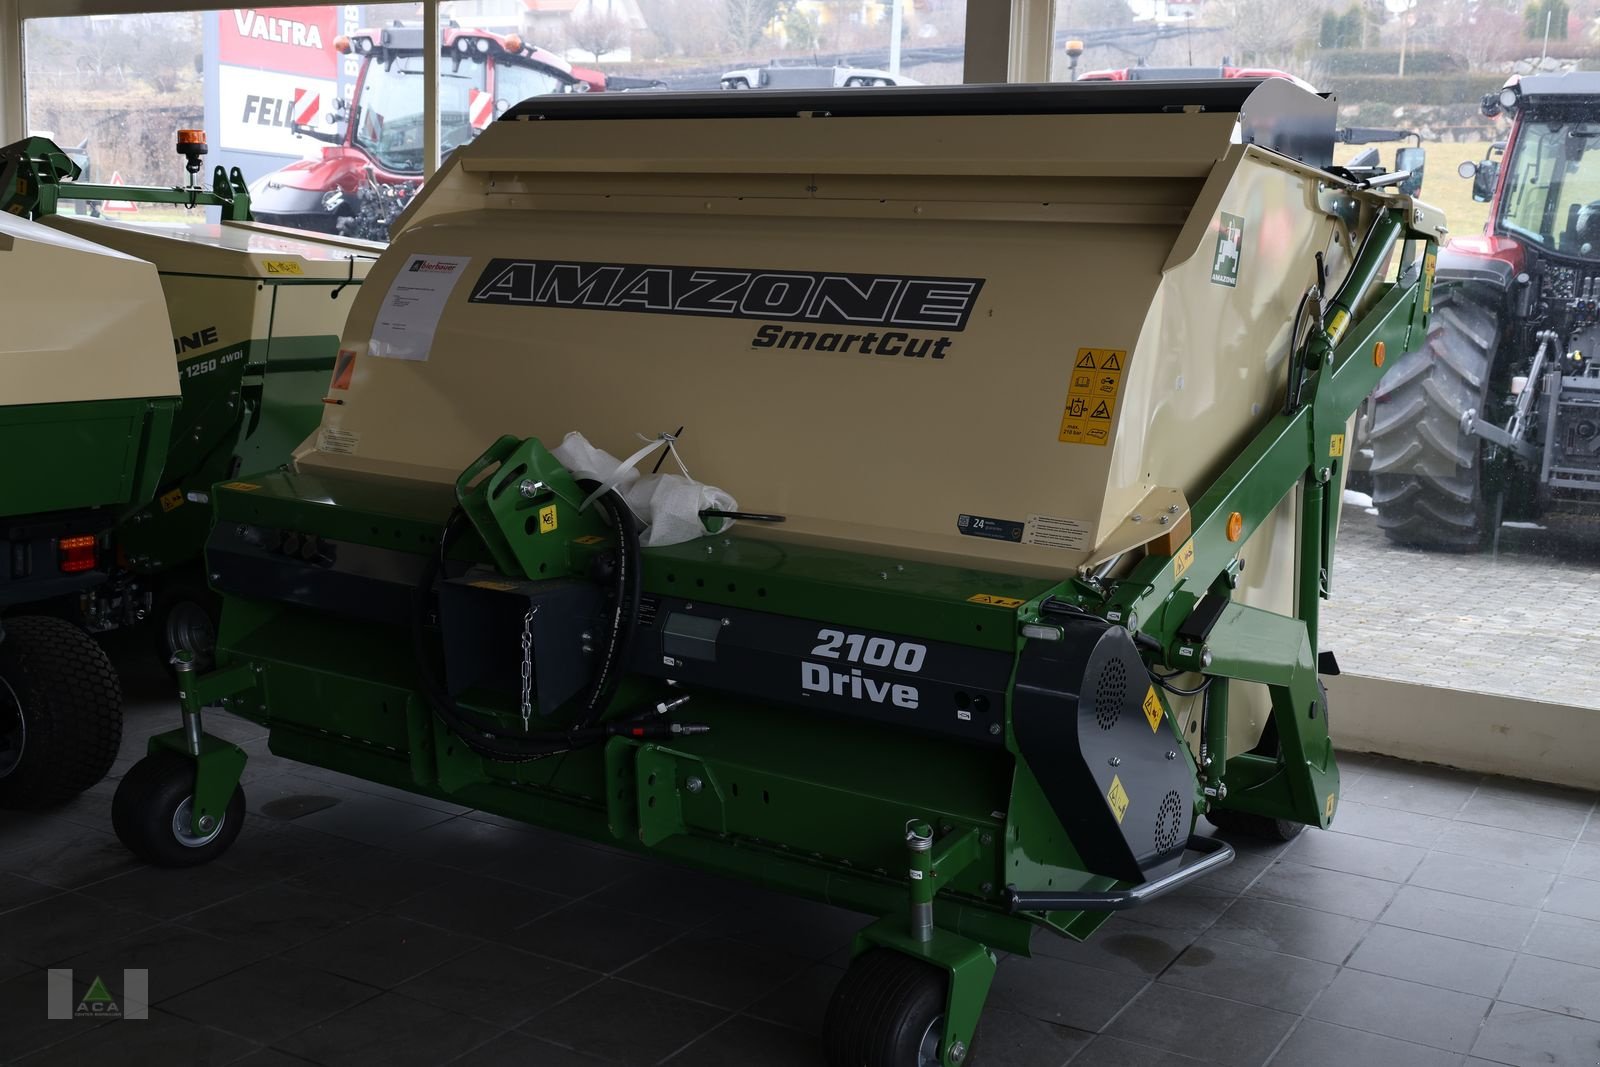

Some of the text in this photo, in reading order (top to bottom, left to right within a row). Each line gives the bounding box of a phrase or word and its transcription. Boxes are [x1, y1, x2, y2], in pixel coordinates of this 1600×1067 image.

[234, 9, 323, 49] VALTRA
[474, 262, 977, 327] AMAZONE
[751, 324, 952, 359] SmartCut
[186, 358, 217, 378] 1250
[973, 518, 984, 528] 24
[810, 628, 927, 673] 2100
[801, 660, 919, 710] Drive
